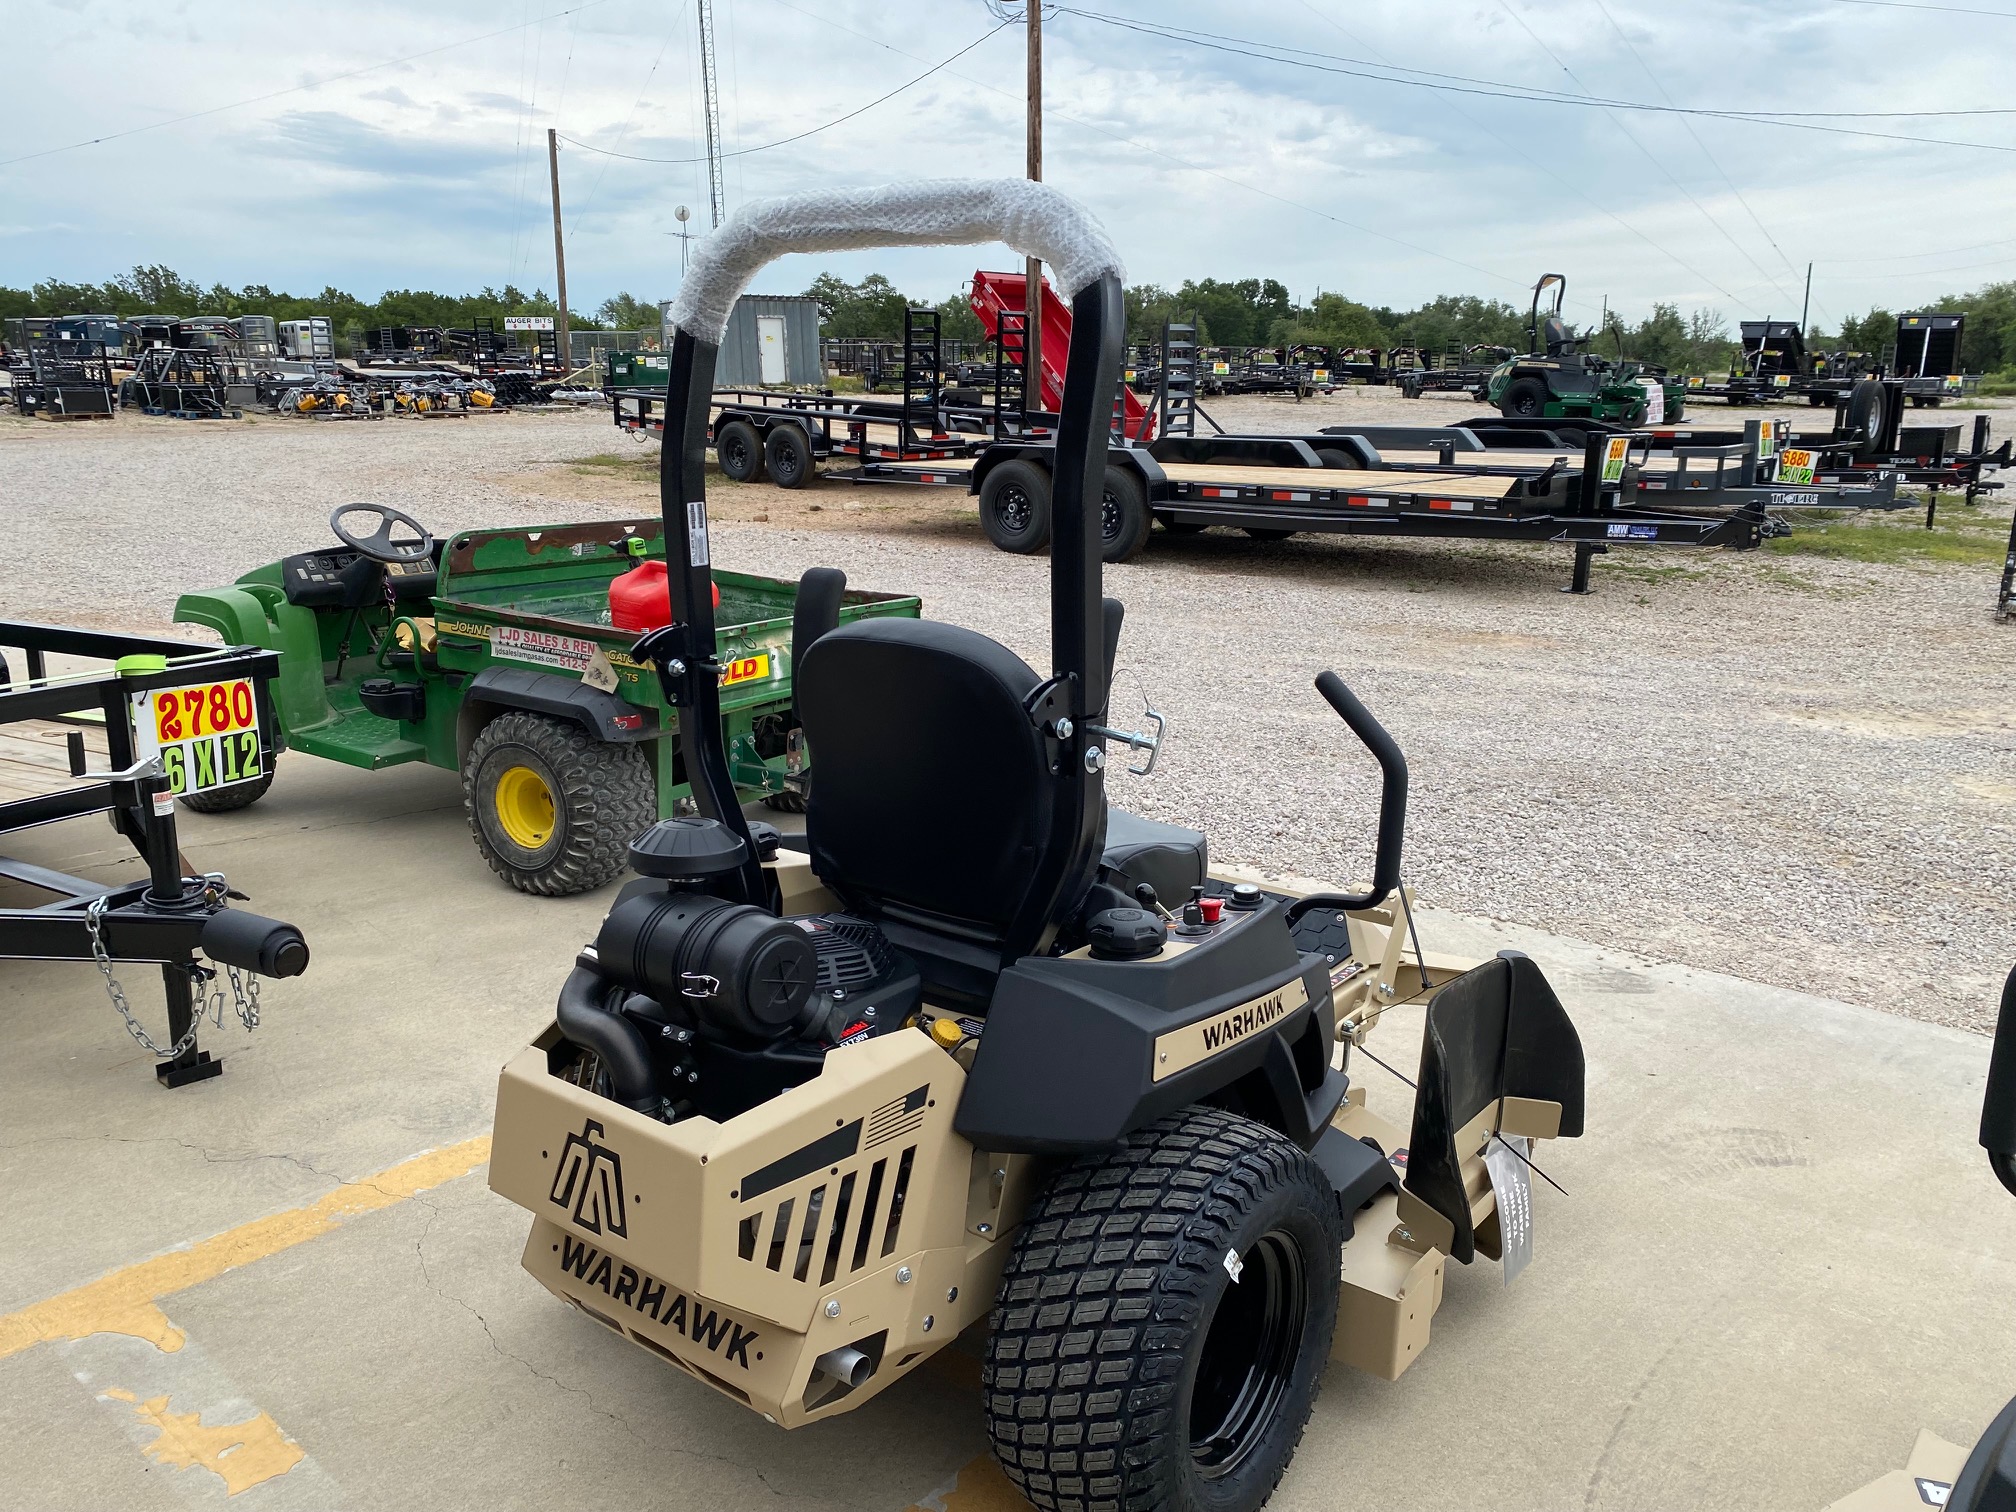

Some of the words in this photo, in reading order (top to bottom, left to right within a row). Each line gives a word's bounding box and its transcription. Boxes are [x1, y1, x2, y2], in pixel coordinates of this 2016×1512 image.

[1790, 467, 1799, 482] X
[1798, 469, 1813, 484] 22
[1879, 470, 1907, 481] lin
[1608, 524, 1629, 534] AMW
[451, 620, 484, 636] JOHN
[499, 627, 520, 642] LJD
[523, 631, 558, 648] SALES
[561, 638, 570, 650] &
[573, 639, 598, 655] REN
[559, 655, 589, 671] 512-5
[608, 650, 635, 664] GATO
[158, 681, 253, 741] 2780
[163, 746, 187, 794] 6
[193, 738, 216, 788] X
[222, 731, 260, 782] 12
[839, 1021, 869, 1039] asaki
[1202, 992, 1285, 1051] WARHAWK
[1509, 1190, 1517, 1218] THE
[1511, 1172, 1525, 1247] WARHAWK
[1521, 1182, 1530, 1229] FAMILY
[1500, 1185, 1513, 1254] WELCOME
[1512, 1219, 1518, 1239] TO
[561, 1234, 760, 1371] WARHAWK
